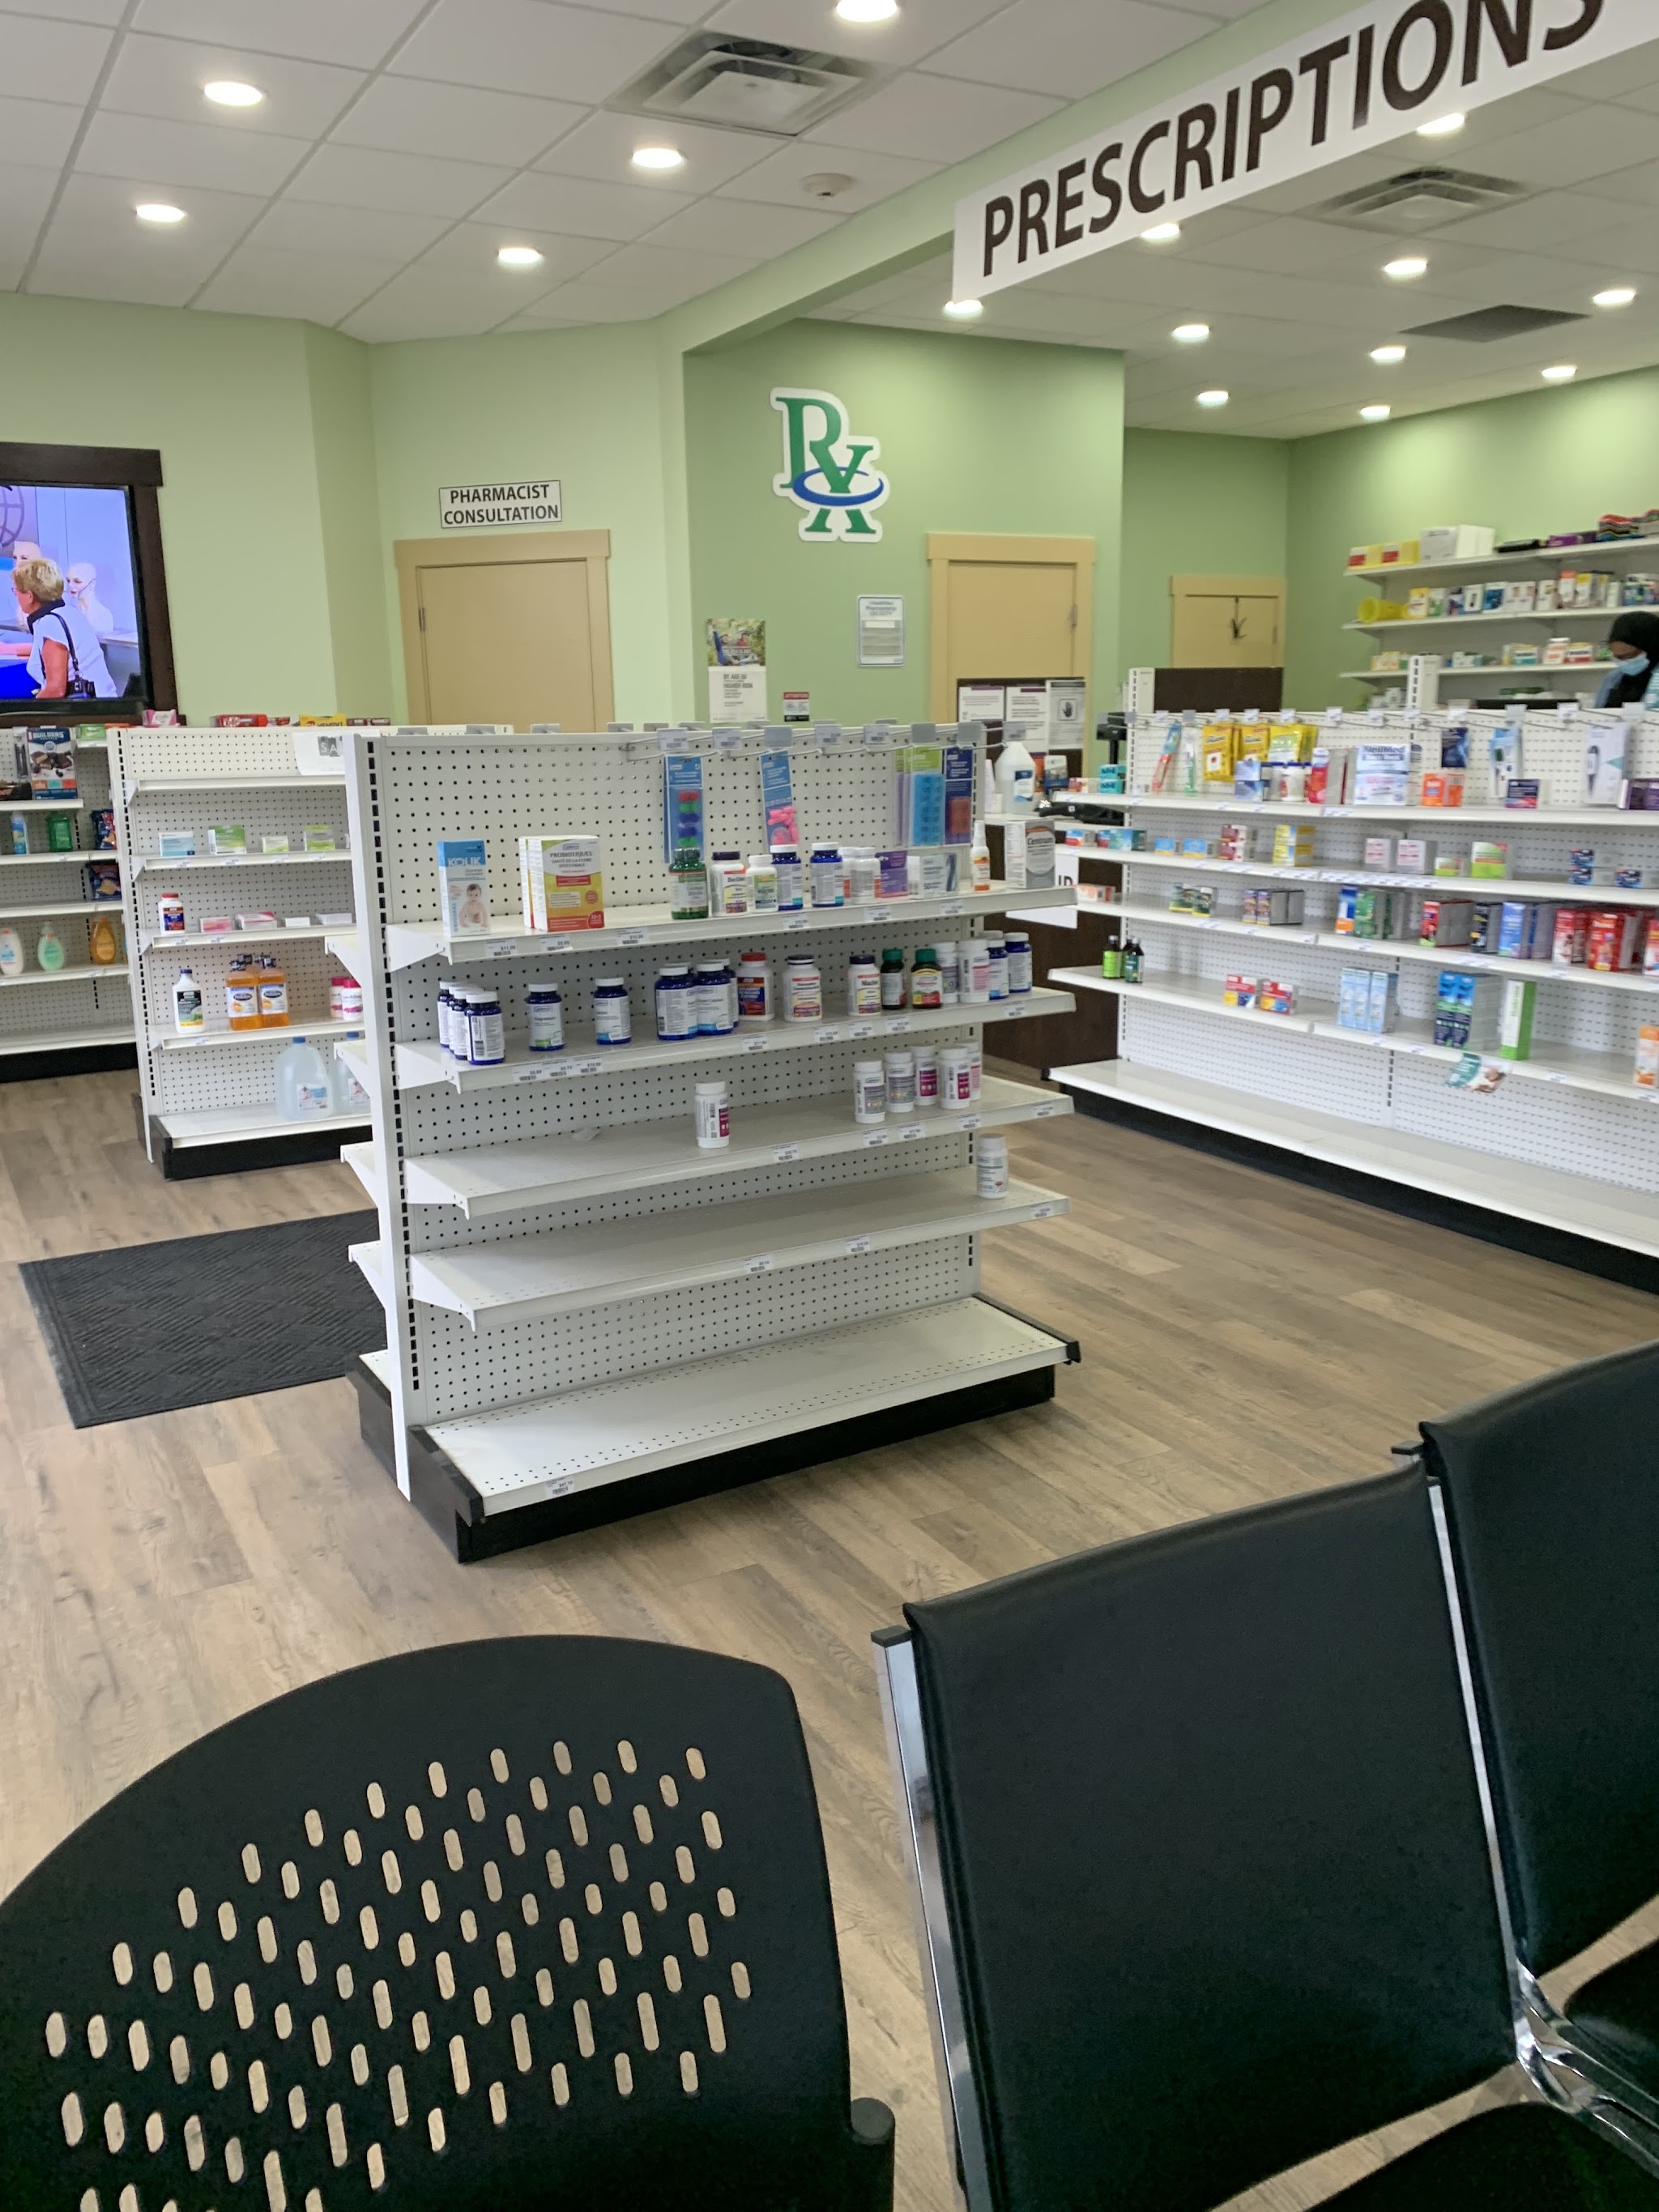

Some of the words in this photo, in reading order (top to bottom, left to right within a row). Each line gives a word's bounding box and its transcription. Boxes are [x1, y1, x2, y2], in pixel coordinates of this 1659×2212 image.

[450, 484, 550, 504] PHARMACIST
[443, 504, 559, 525] CONSULTATION
[1027, 837, 1055, 846] Centrum
[447, 856, 482, 867] KOLIK
